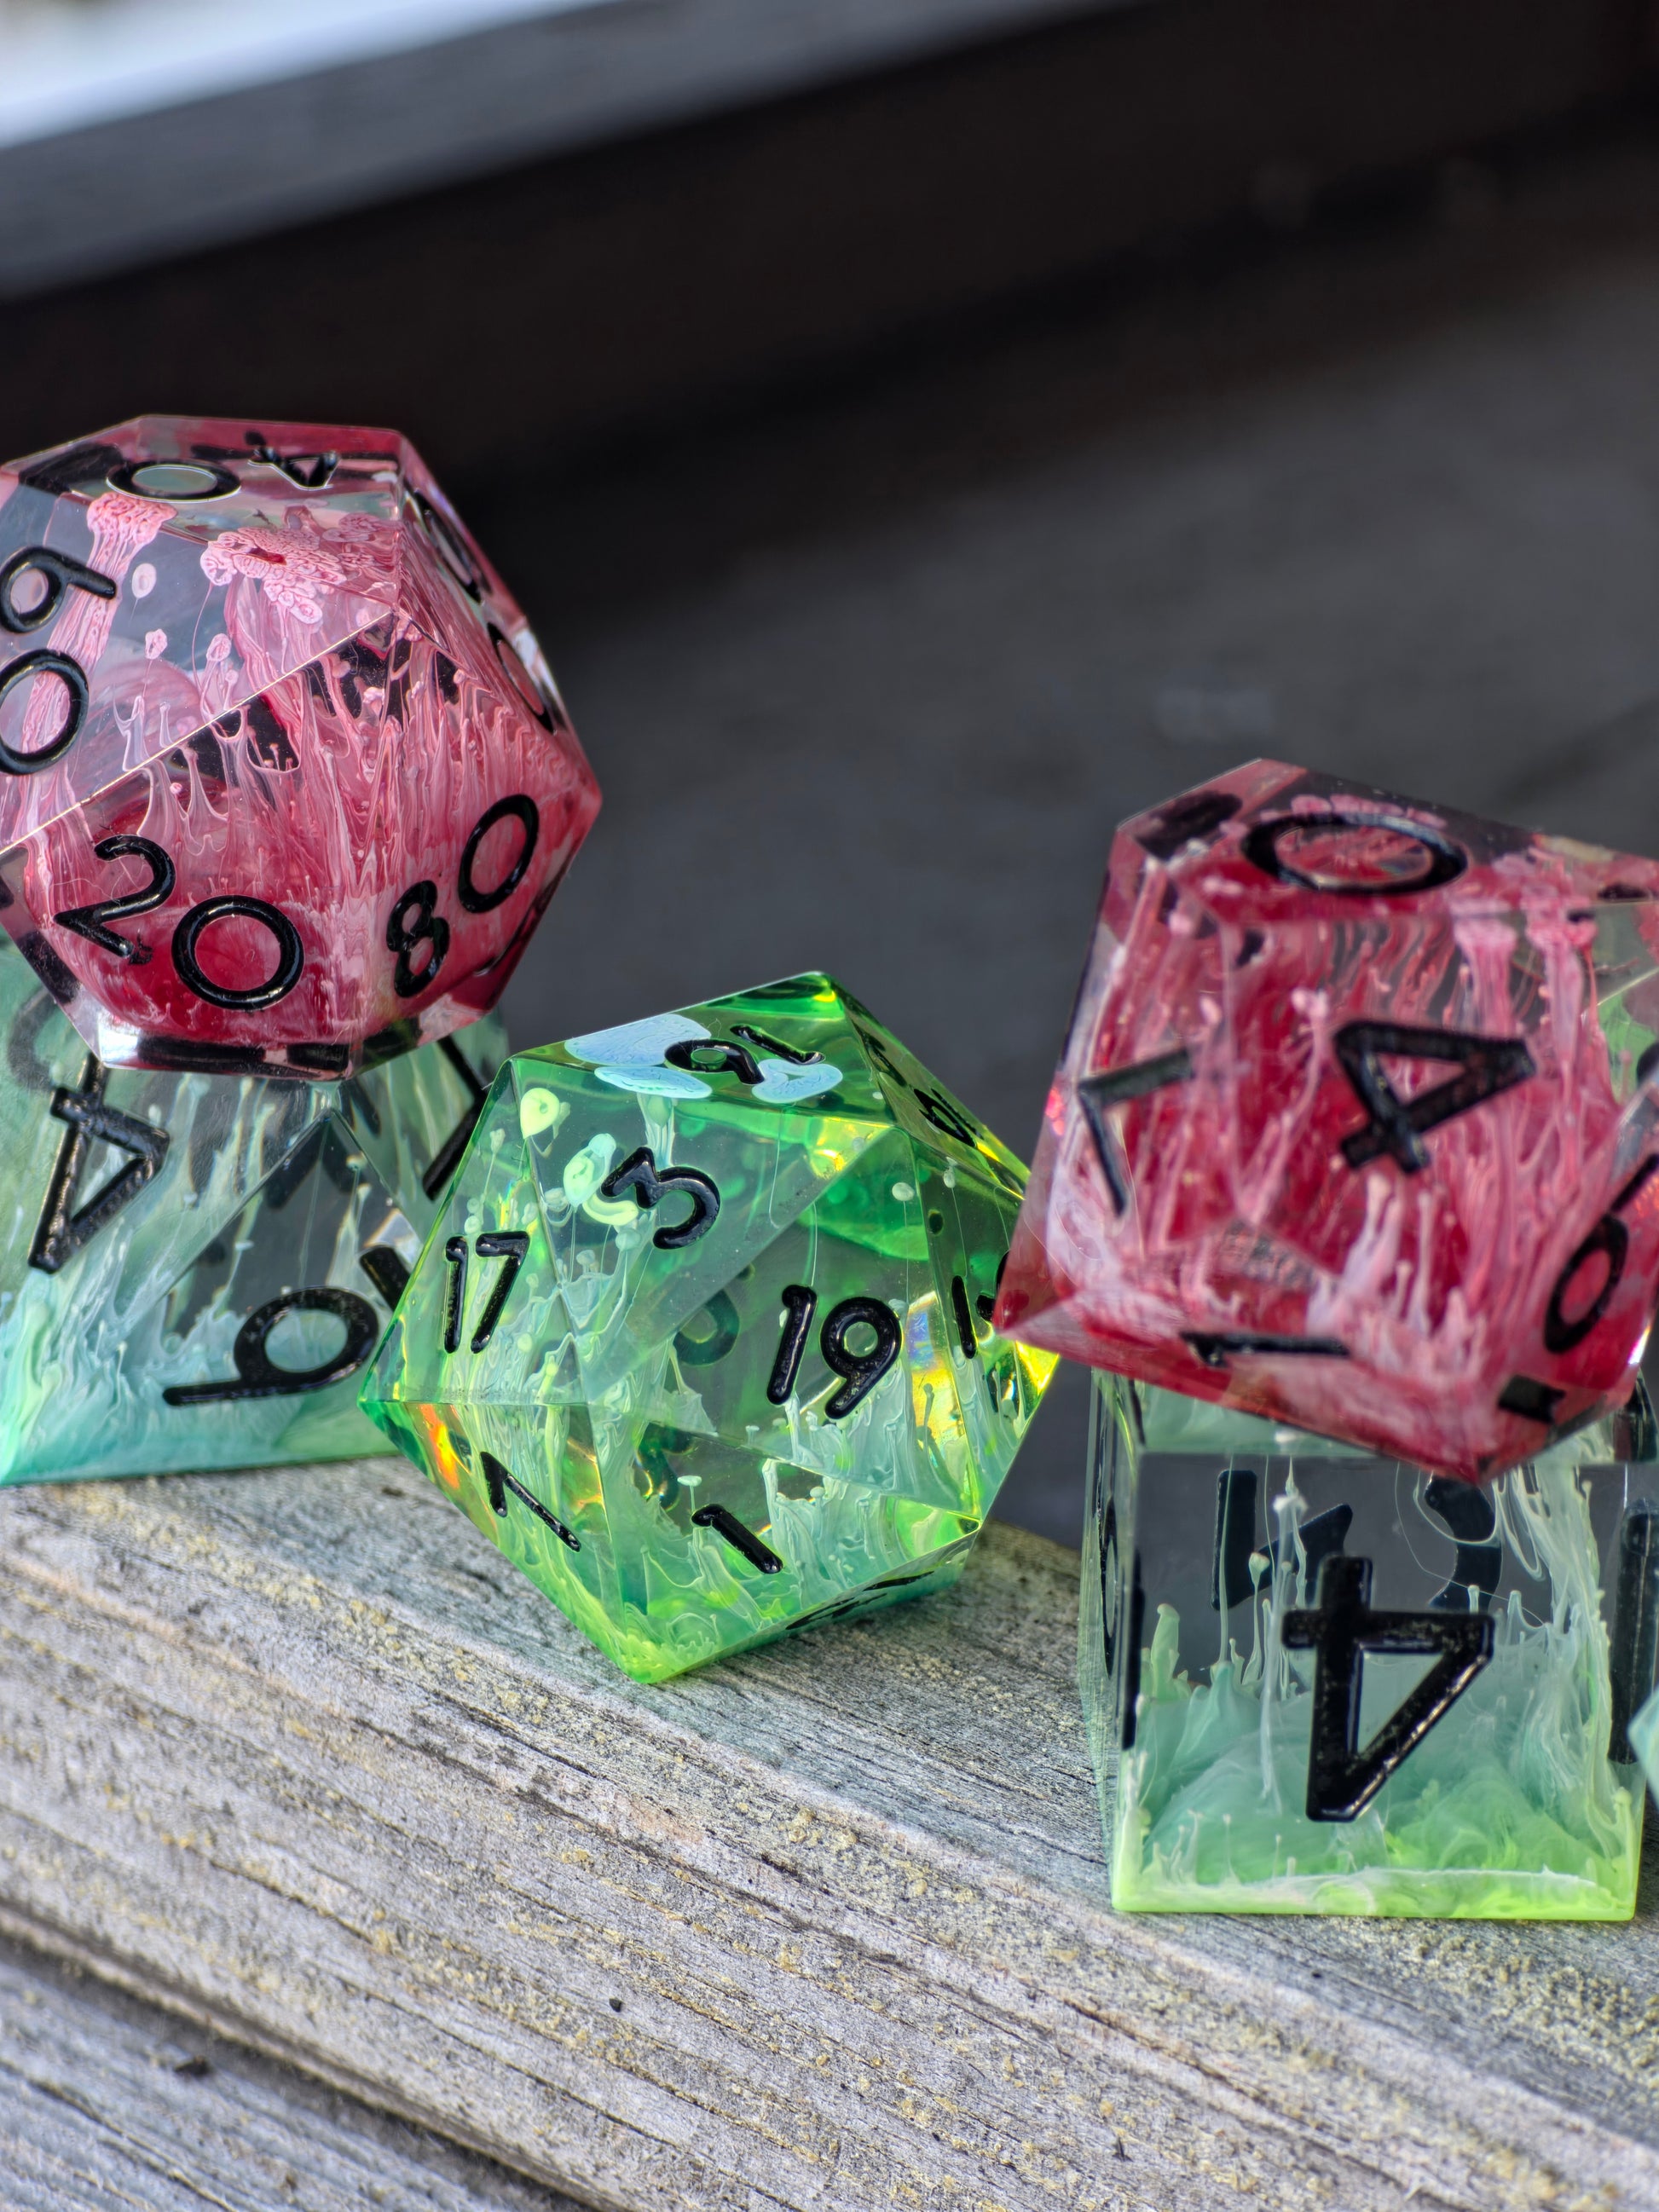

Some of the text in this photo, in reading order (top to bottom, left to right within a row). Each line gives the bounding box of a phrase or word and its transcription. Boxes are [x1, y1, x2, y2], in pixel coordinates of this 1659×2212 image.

[53, 835, 304, 1011] 20
[386, 794, 540, 998] 80
[1243, 811, 1470, 895] 0
[28, 1052, 170, 1273] 4
[1334, 1019, 1534, 1175] 4
[601, 1146, 721, 1250] 3
[444, 1230, 530, 1354] 17
[766, 1284, 903, 1419] 19
[691, 1487, 783, 1574] 1
[1282, 1556, 1495, 1823] 4
